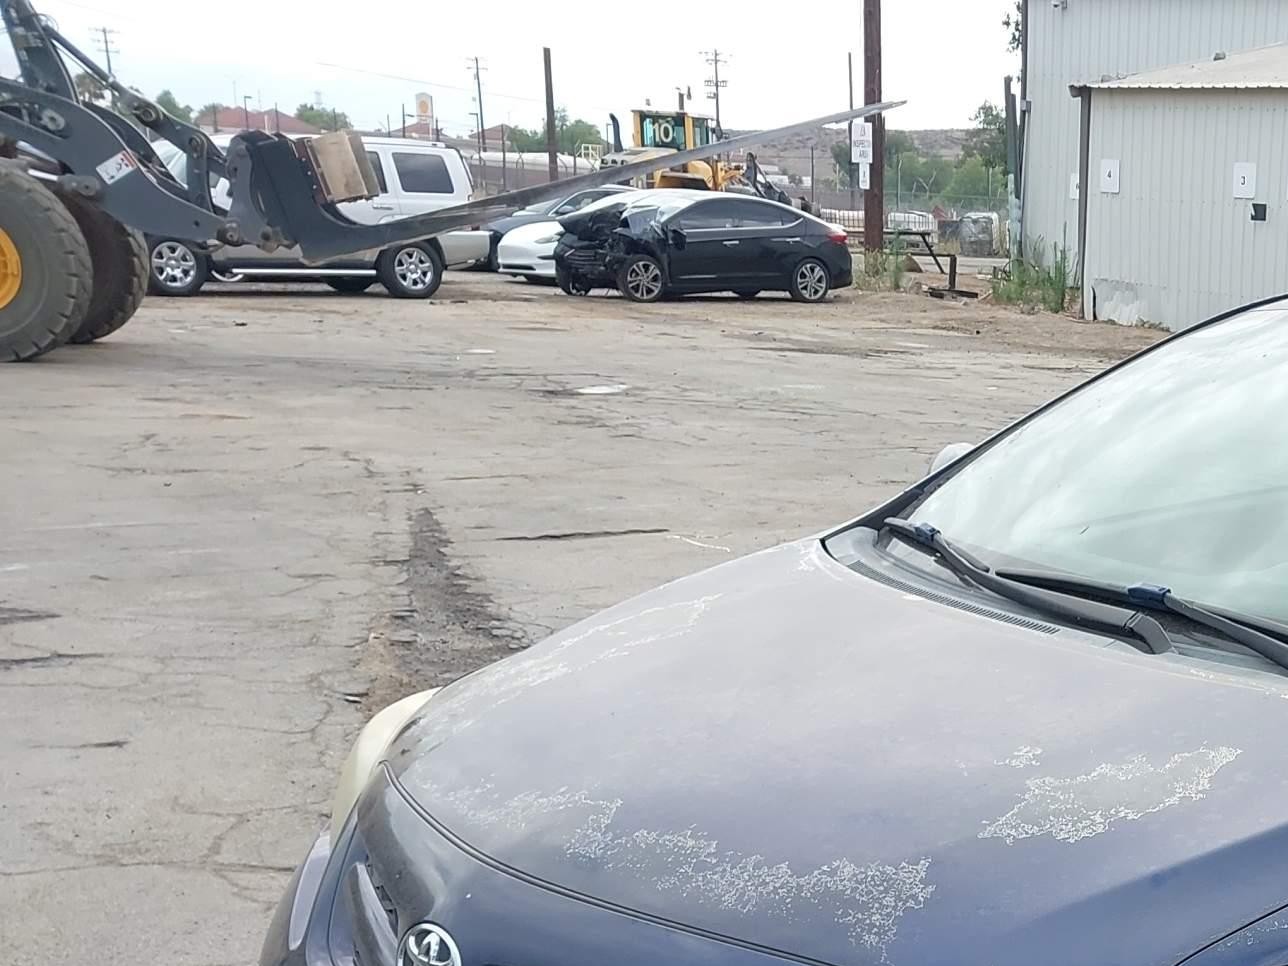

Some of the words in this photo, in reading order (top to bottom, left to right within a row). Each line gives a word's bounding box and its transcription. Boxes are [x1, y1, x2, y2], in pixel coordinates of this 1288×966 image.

[653, 122, 673, 142] 10
[1106, 169, 1112, 179] 4
[1240, 175, 1246, 186] 3
